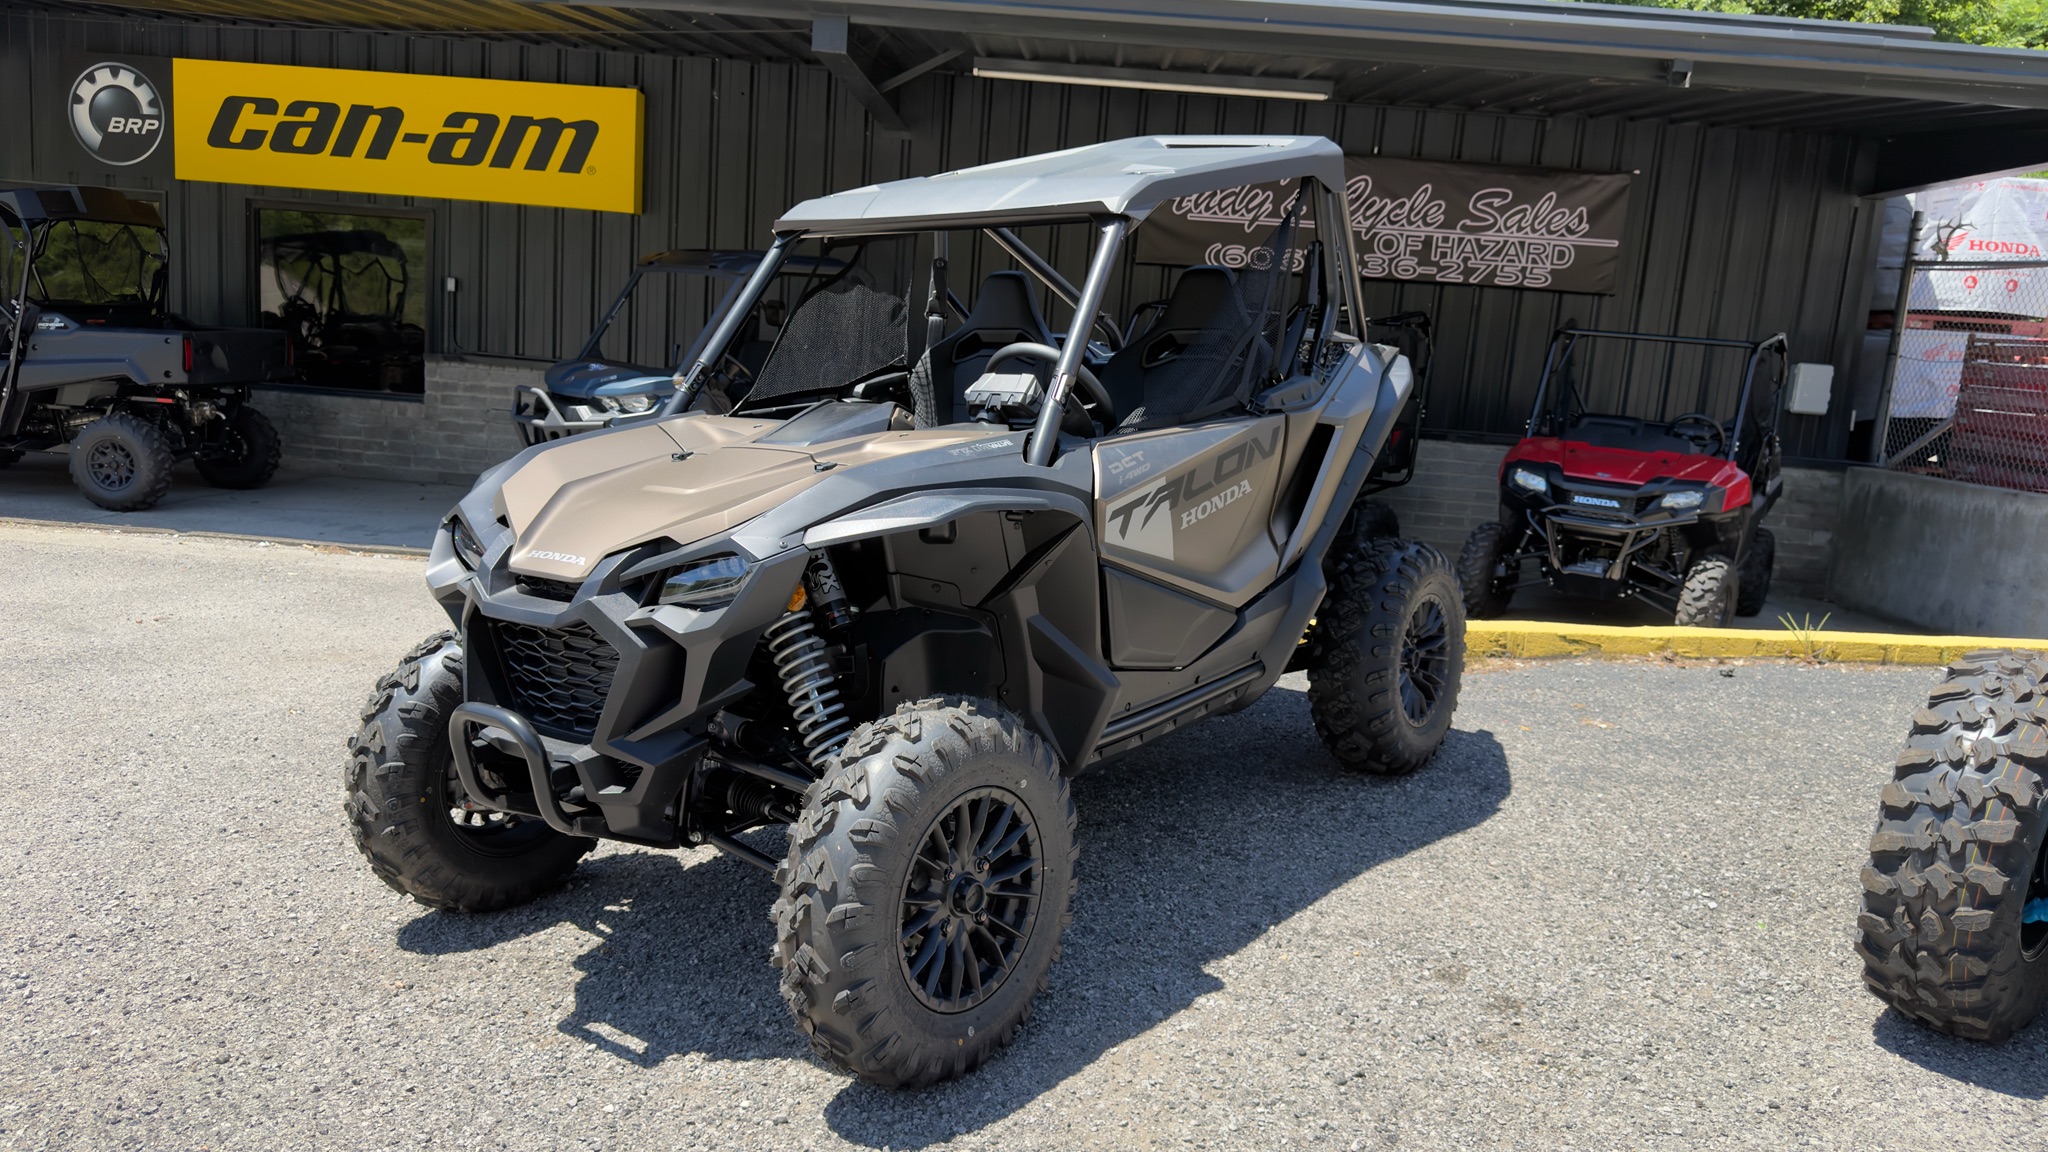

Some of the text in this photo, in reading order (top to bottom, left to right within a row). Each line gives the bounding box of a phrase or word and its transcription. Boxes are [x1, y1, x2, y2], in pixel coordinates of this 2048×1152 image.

[107, 116, 160, 135] BRP
[206, 95, 600, 175] can-am
[1172, 178, 1308, 233] udy
[1456, 187, 1590, 239] Sales
[1374, 232, 1576, 270] OF HAZARD
[1967, 239, 2041, 257] HONDA
[1355, 252, 1552, 288] 36-2755
[1107, 450, 1145, 475] DCT
[1107, 424, 1281, 541] TALON
[1179, 478, 1253, 531] HONDA
[1572, 495, 1621, 509] HONDA
[526, 549, 587, 567] HONDA
